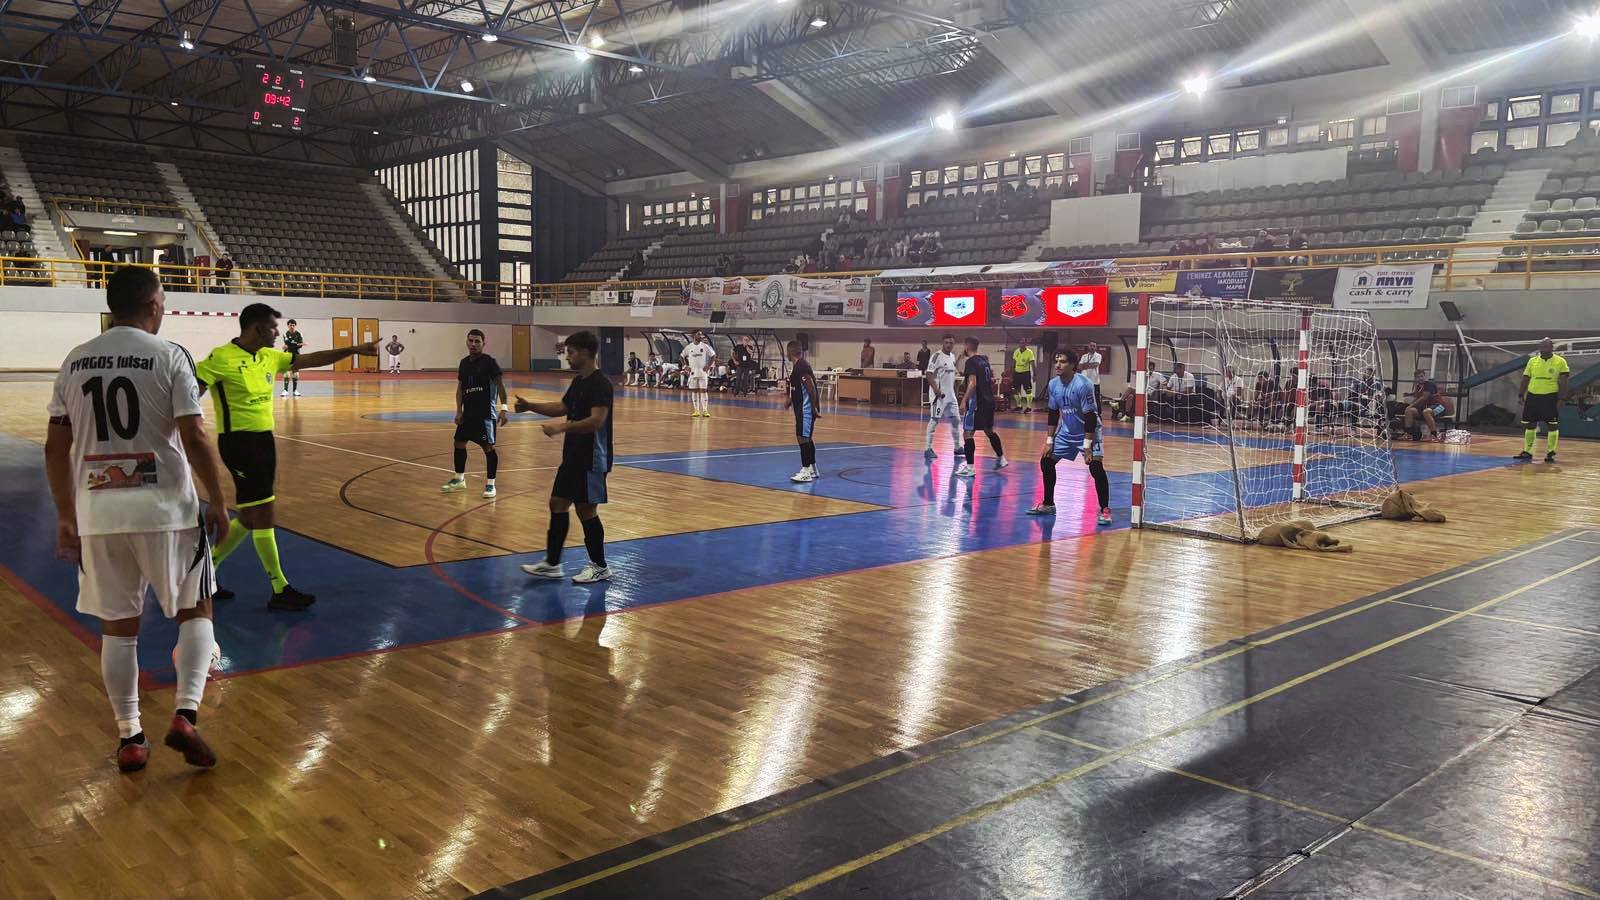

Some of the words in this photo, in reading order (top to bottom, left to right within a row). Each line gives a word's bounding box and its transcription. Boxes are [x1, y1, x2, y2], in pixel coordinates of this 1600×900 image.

[262, 73, 269, 84] 2
[275, 76, 281, 85] 2
[299, 79, 304, 89] 7
[293, 116, 300, 125] 2
[1349, 288, 1372, 296] cash
[1386, 289, 1414, 298] carry
[70, 356, 114, 374] PYRGOS
[81, 376, 140, 441] 10
